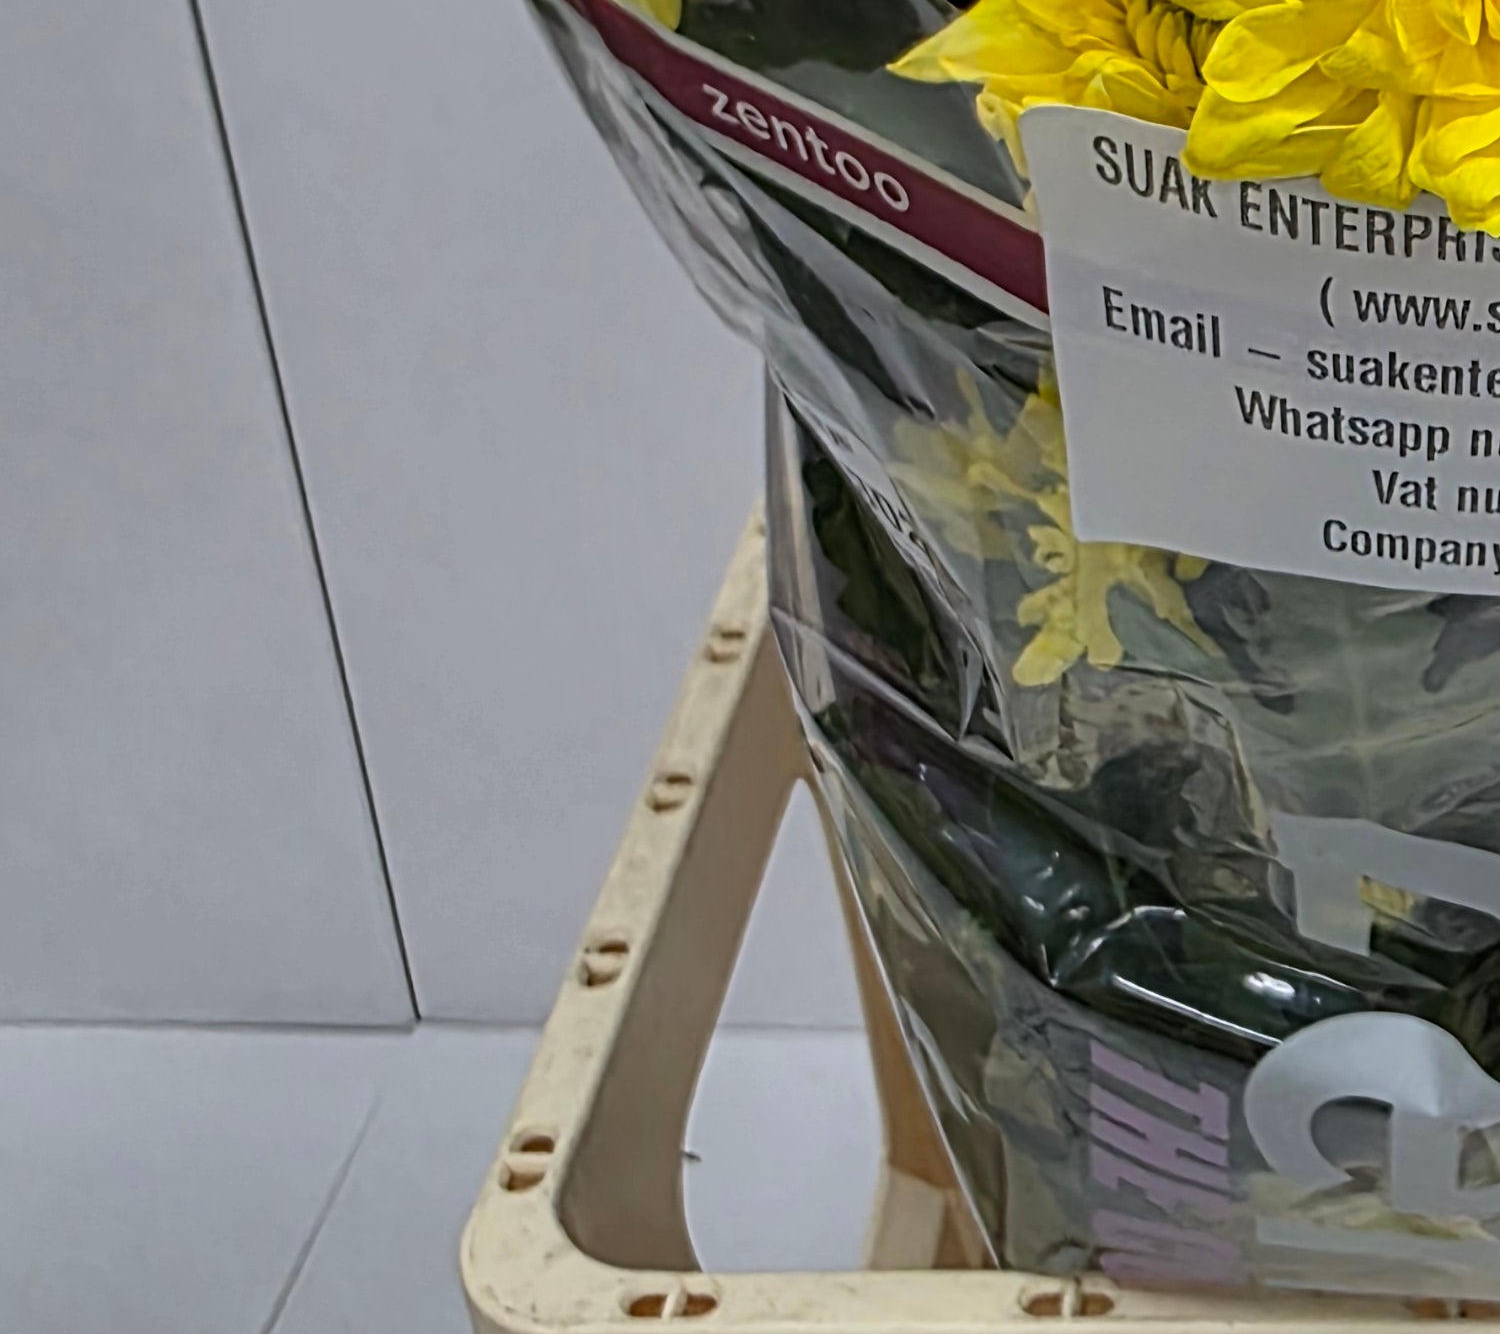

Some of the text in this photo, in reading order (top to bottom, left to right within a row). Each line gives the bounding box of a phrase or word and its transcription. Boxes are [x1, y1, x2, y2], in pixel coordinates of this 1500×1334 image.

[702, 83, 911, 214] zentoo
[1092, 135, 1218, 219] SUAK
[1101, 285, 1222, 359] Email
[1233, 385, 1450, 462] Whatsapp
[1372, 470, 1437, 511] Vat
